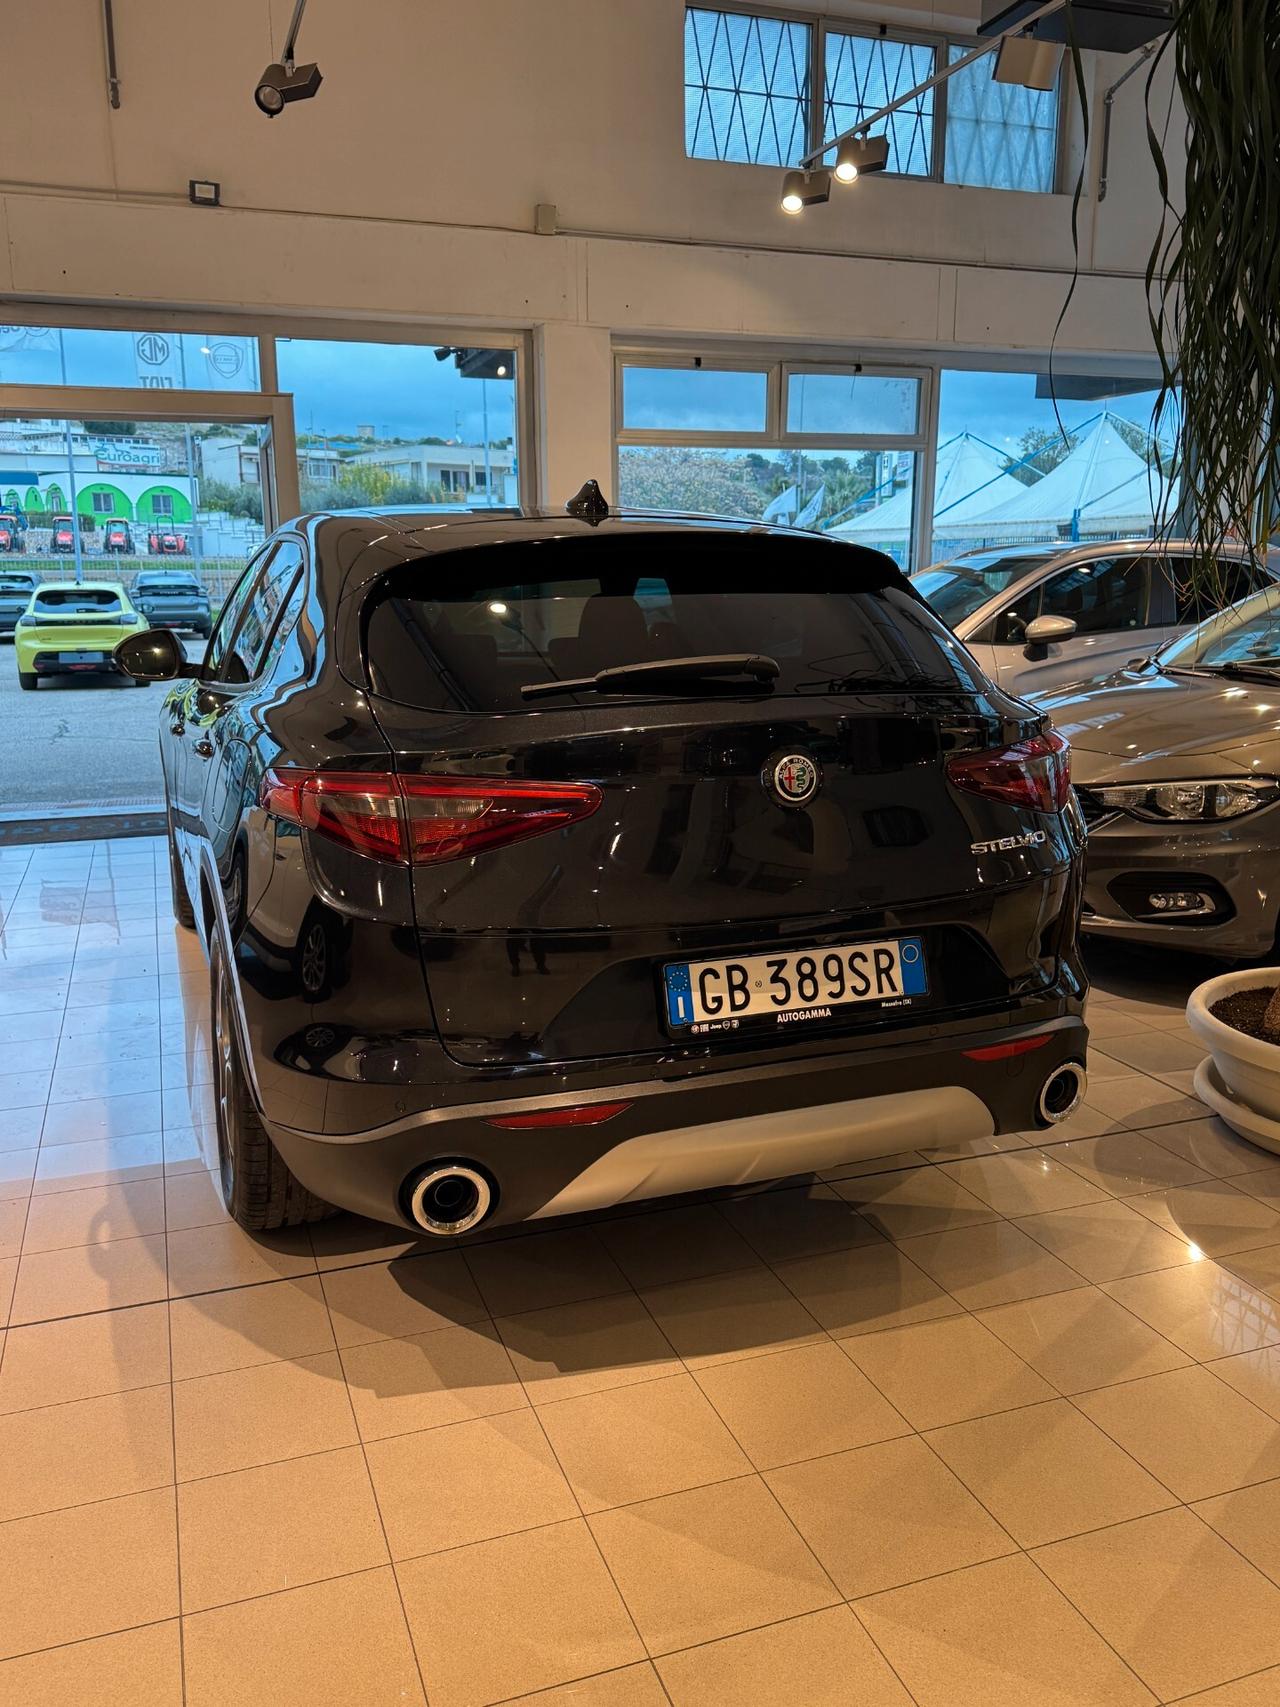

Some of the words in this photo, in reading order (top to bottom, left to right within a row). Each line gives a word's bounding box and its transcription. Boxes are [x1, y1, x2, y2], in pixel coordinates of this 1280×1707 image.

[94, 448, 160, 465] Euroagri
[793, 758, 814, 778] ROMEO
[970, 830, 1046, 854] STELVIO
[698, 964, 751, 1016] GB
[766, 948, 898, 1006] 389SR
[776, 1007, 832, 1023] AUTOGAMMA
